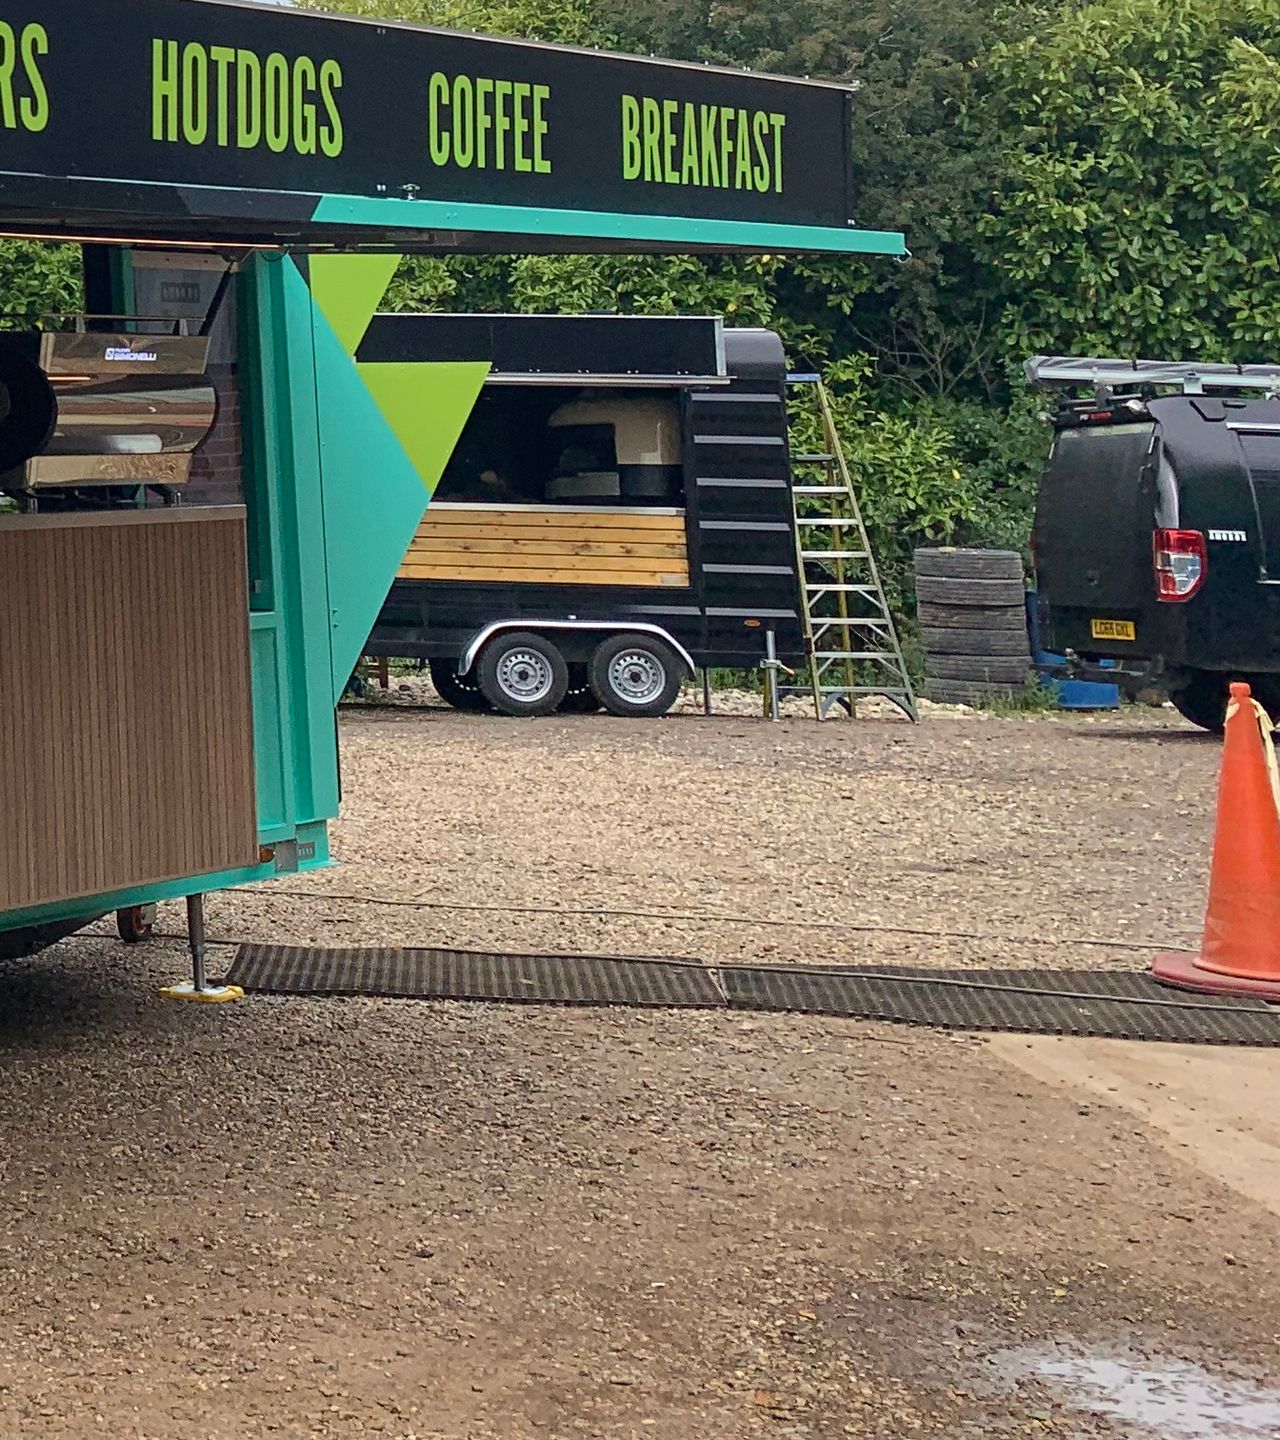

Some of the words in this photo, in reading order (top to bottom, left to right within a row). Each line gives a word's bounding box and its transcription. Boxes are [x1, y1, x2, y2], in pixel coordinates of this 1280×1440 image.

[152, 38, 343, 158] HOTDOGS
[429, 72, 552, 174] COFFEE
[622, 95, 786, 193] BREAKFAST
